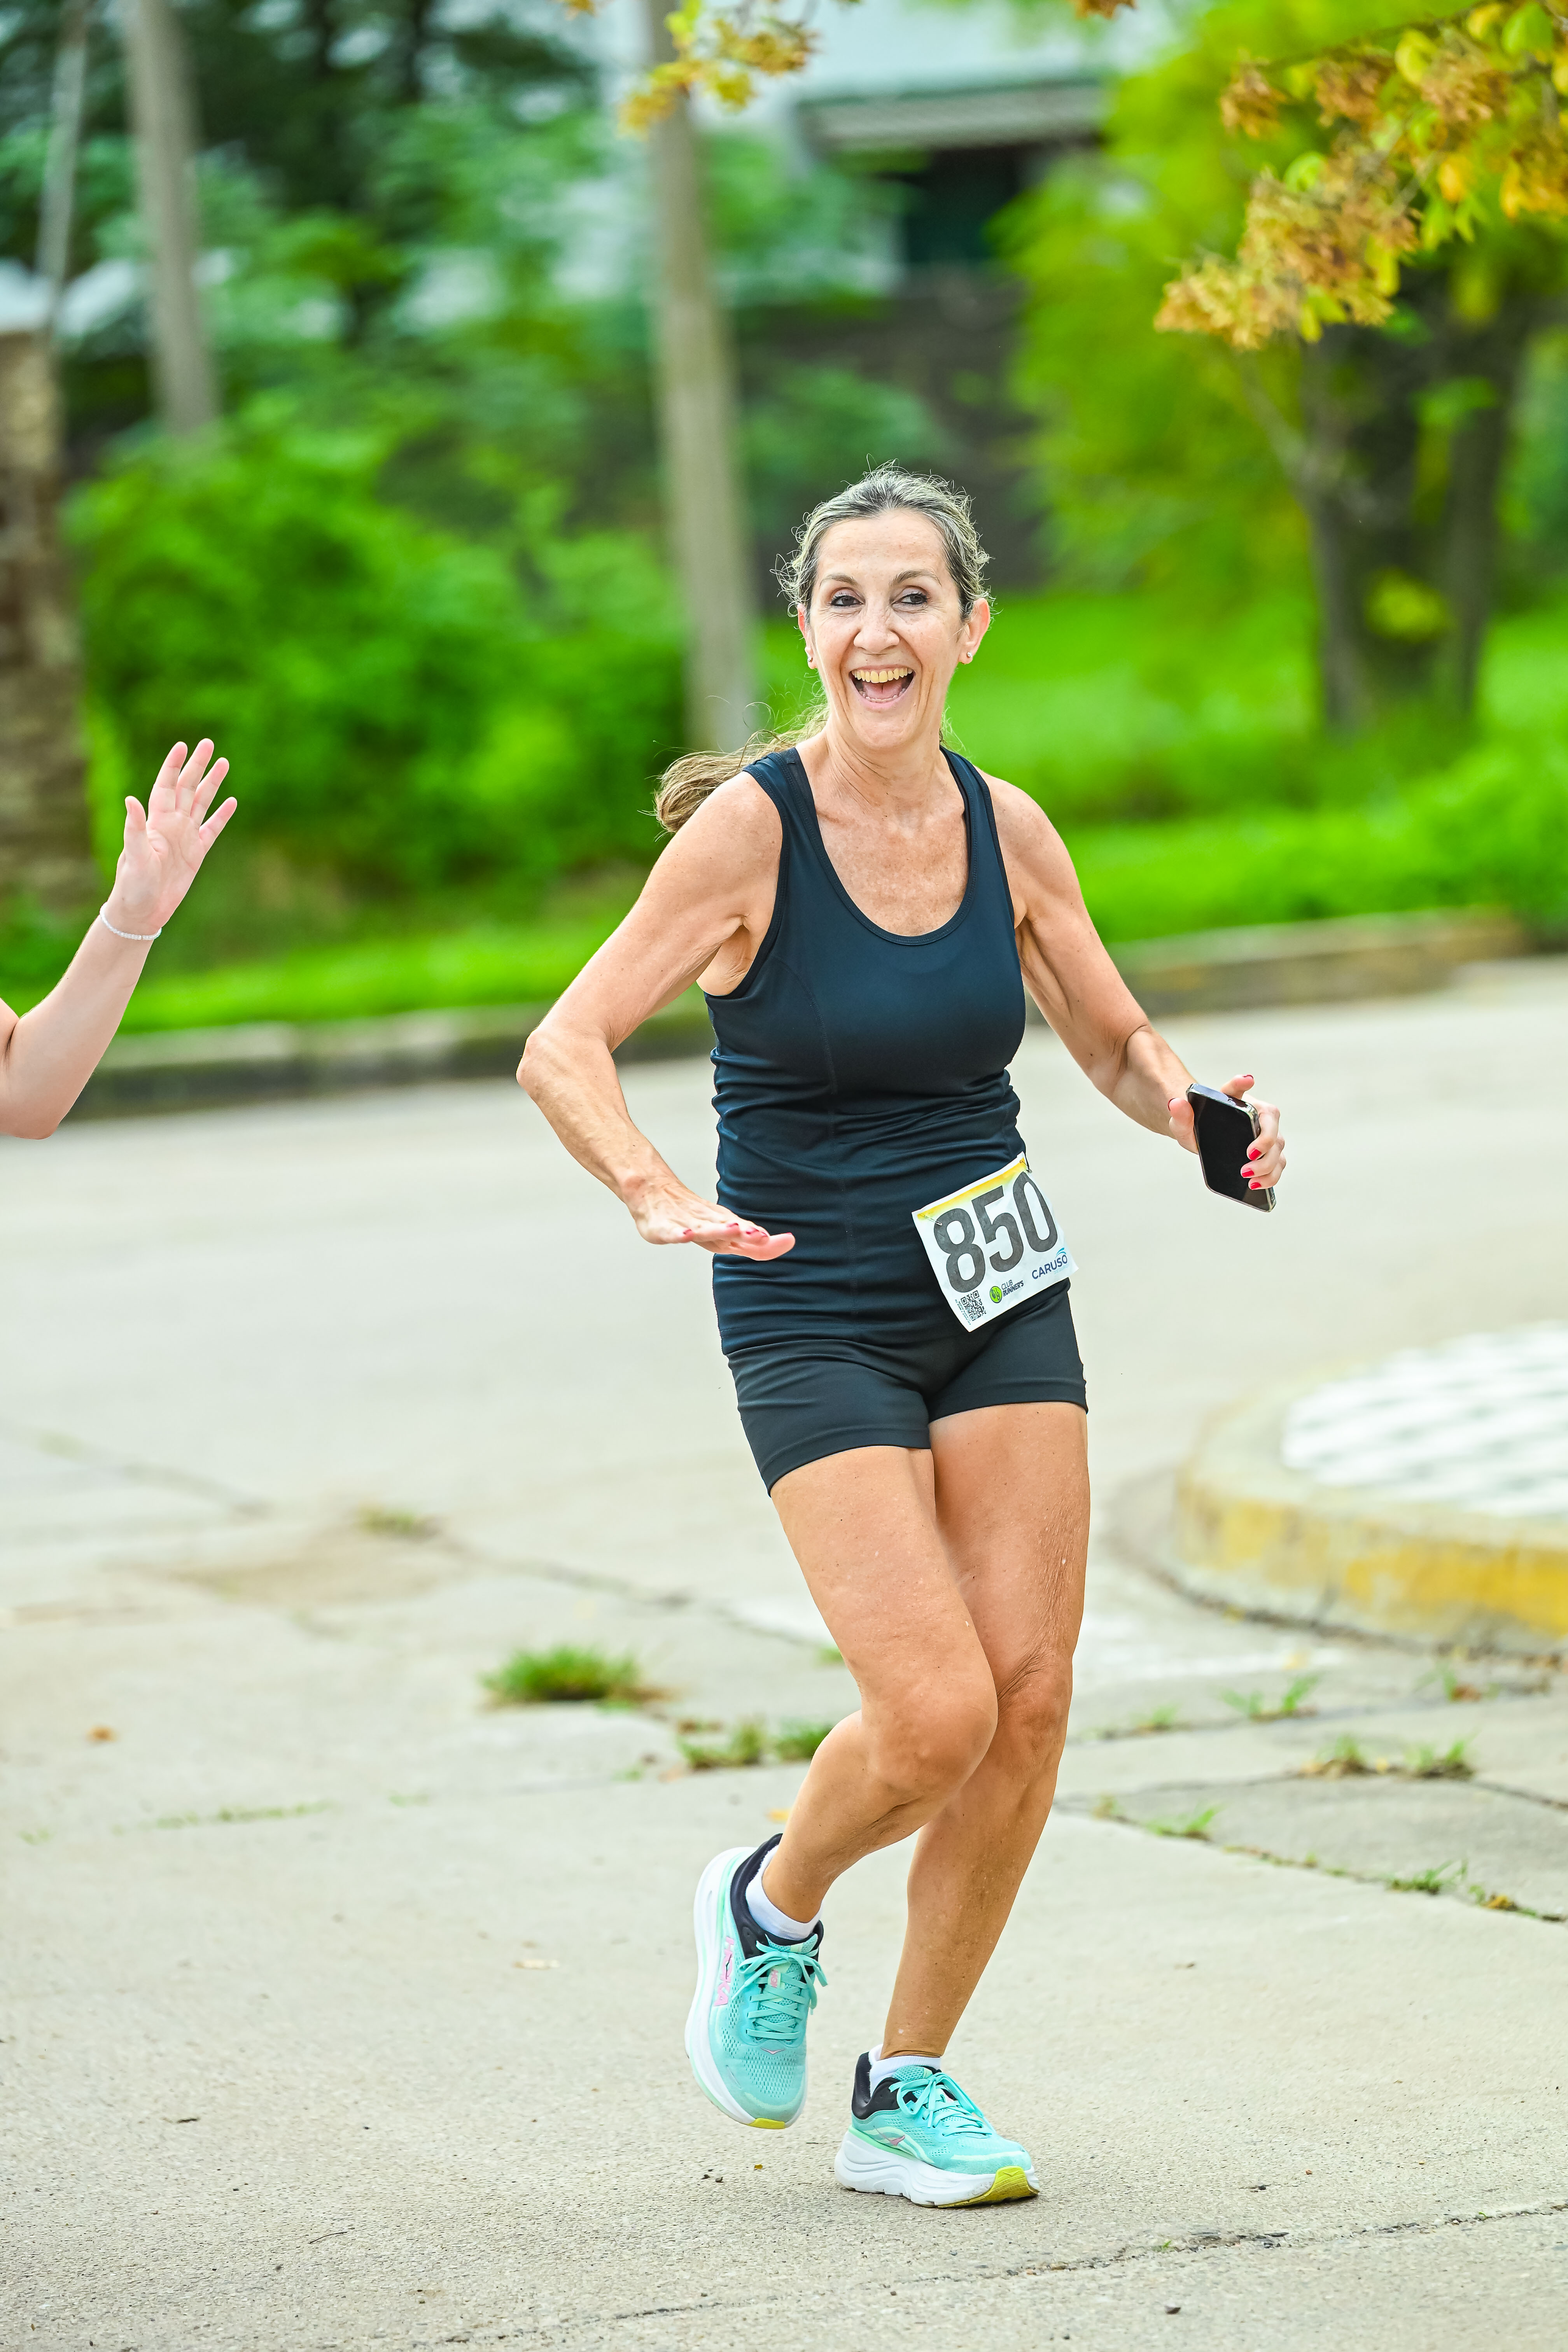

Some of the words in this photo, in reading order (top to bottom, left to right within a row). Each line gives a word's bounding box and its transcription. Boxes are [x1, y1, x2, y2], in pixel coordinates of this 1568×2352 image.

[934, 1171, 1058, 1293] 850
[1032, 1255, 1068, 1279] CARUSO
[1001, 1280, 1013, 1290] CLUB
[1003, 1280, 1024, 1297] RUNNER'S
[713, 1936, 734, 2006] HOKA
